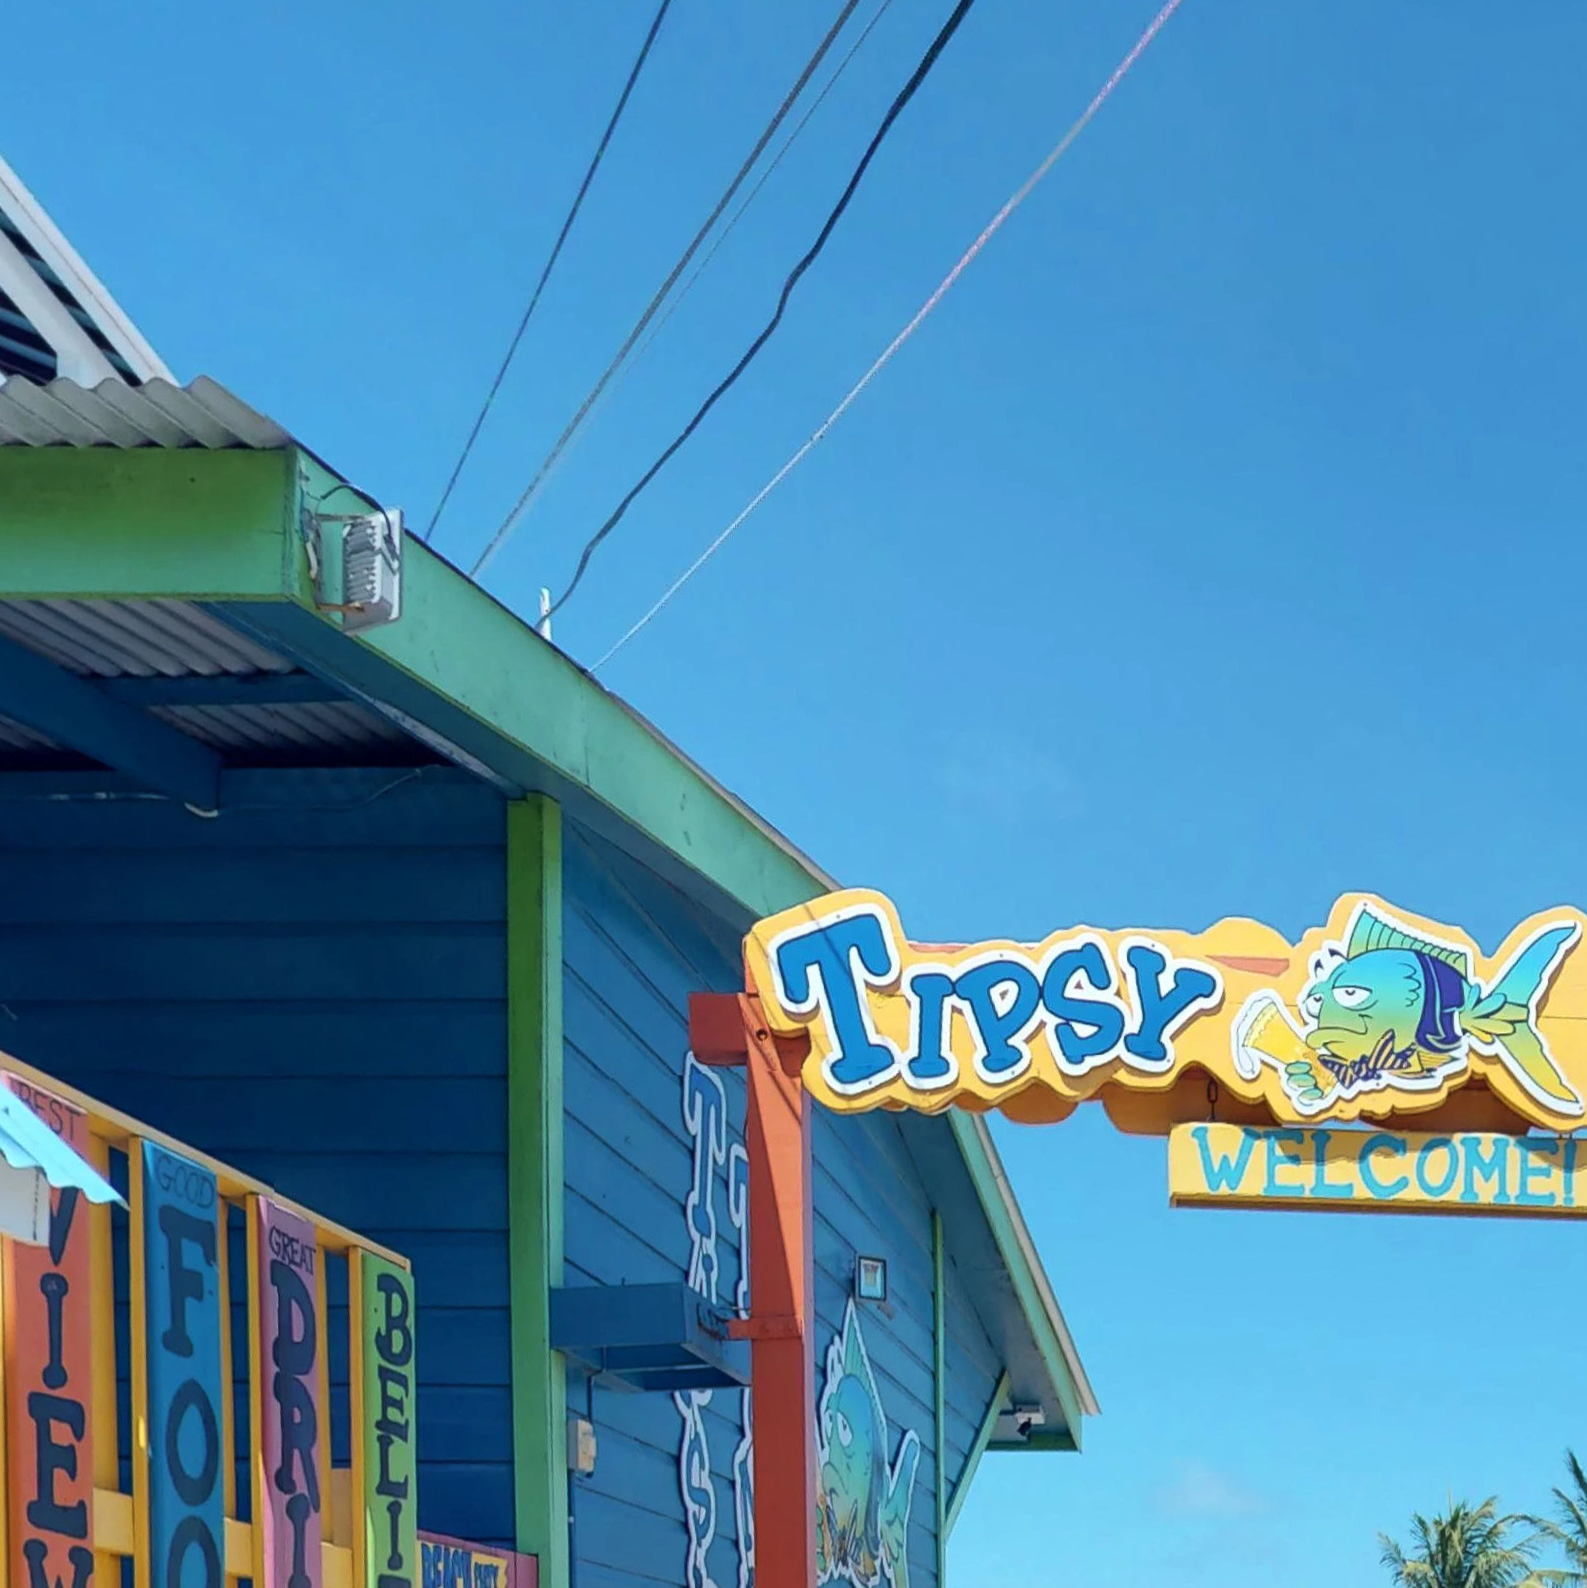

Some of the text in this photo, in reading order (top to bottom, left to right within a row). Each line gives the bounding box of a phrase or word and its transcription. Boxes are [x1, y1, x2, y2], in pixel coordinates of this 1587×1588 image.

[772, 909, 1219, 1088] TIPSY
[156, 1153, 217, 1209] GOOD
[1190, 1125, 1577, 1206] WELCOME!
[268, 1226, 318, 1276] GREAT
